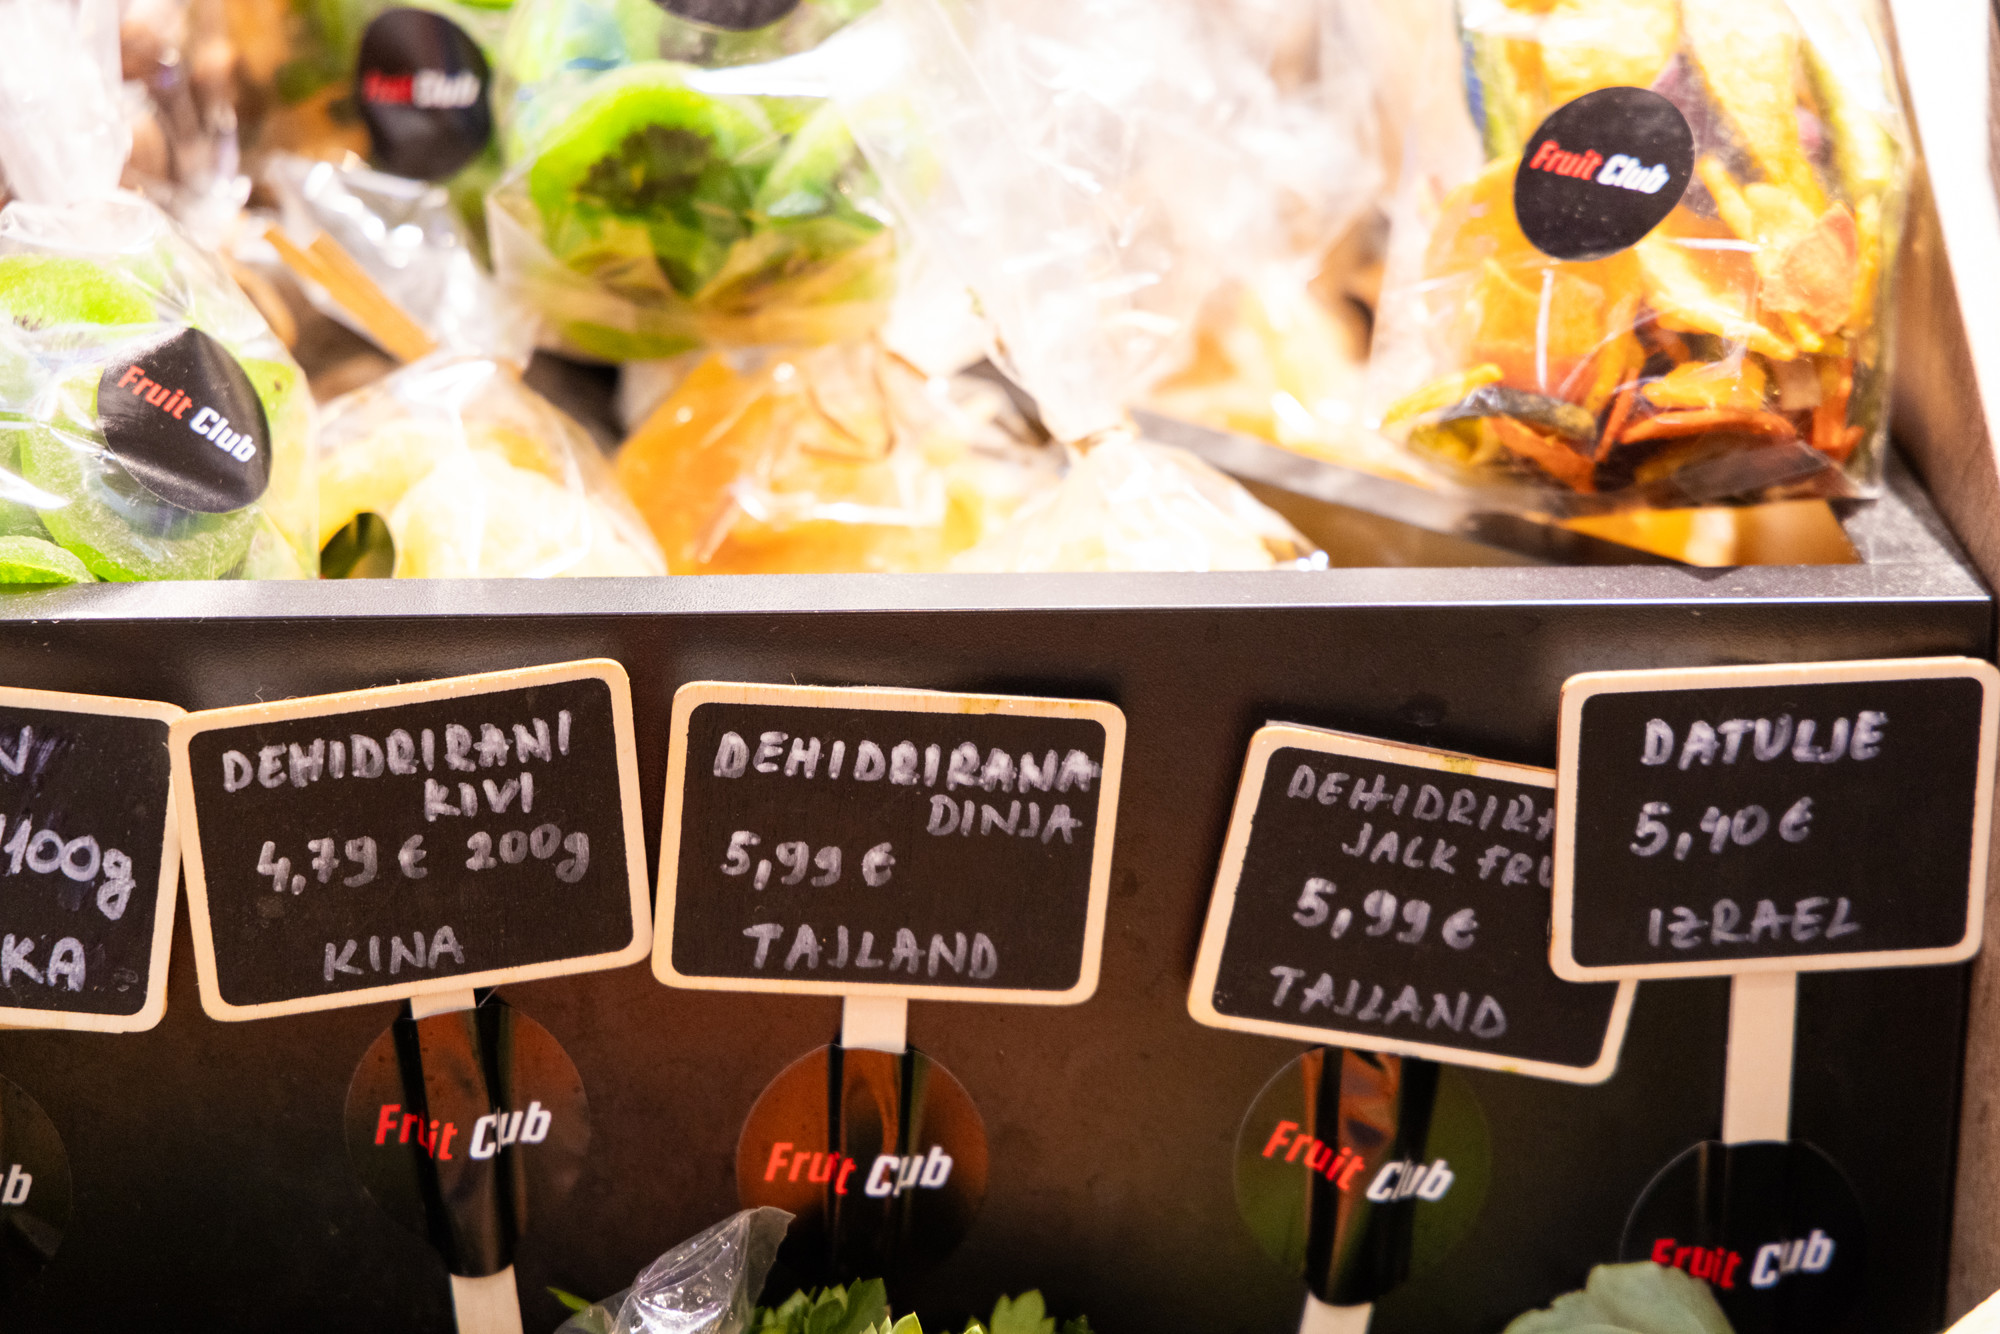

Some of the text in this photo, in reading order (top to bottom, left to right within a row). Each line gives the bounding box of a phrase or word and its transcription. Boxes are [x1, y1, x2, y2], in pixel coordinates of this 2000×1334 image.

[1529, 140, 1671, 195] Fruit Club
[117, 365, 257, 463] Fruit Club
[222, 710, 573, 793] DEHIDRIRANI
[713, 730, 1102, 793] DEHIDRIRANA
[423, 772, 535, 822] KIVI
[926, 794, 1083, 844] DINJA
[256, 823, 590, 896] 4,79 € 200g
[720, 830, 896, 891] 5,99 €
[1341, 822, 1459, 874] JACK
[1292, 877, 1432, 944] 5,99
[1648, 897, 1861, 949] IZRAEL
[323, 925, 465, 982] KINA
[742, 923, 999, 979] TAJLAND
[1270, 965, 1508, 1038] TAJLAND
[764, 1142, 857, 1195] Frut
[1262, 1120, 1365, 1191] Fruit
[1750, 1229, 1836, 1288] Cub
